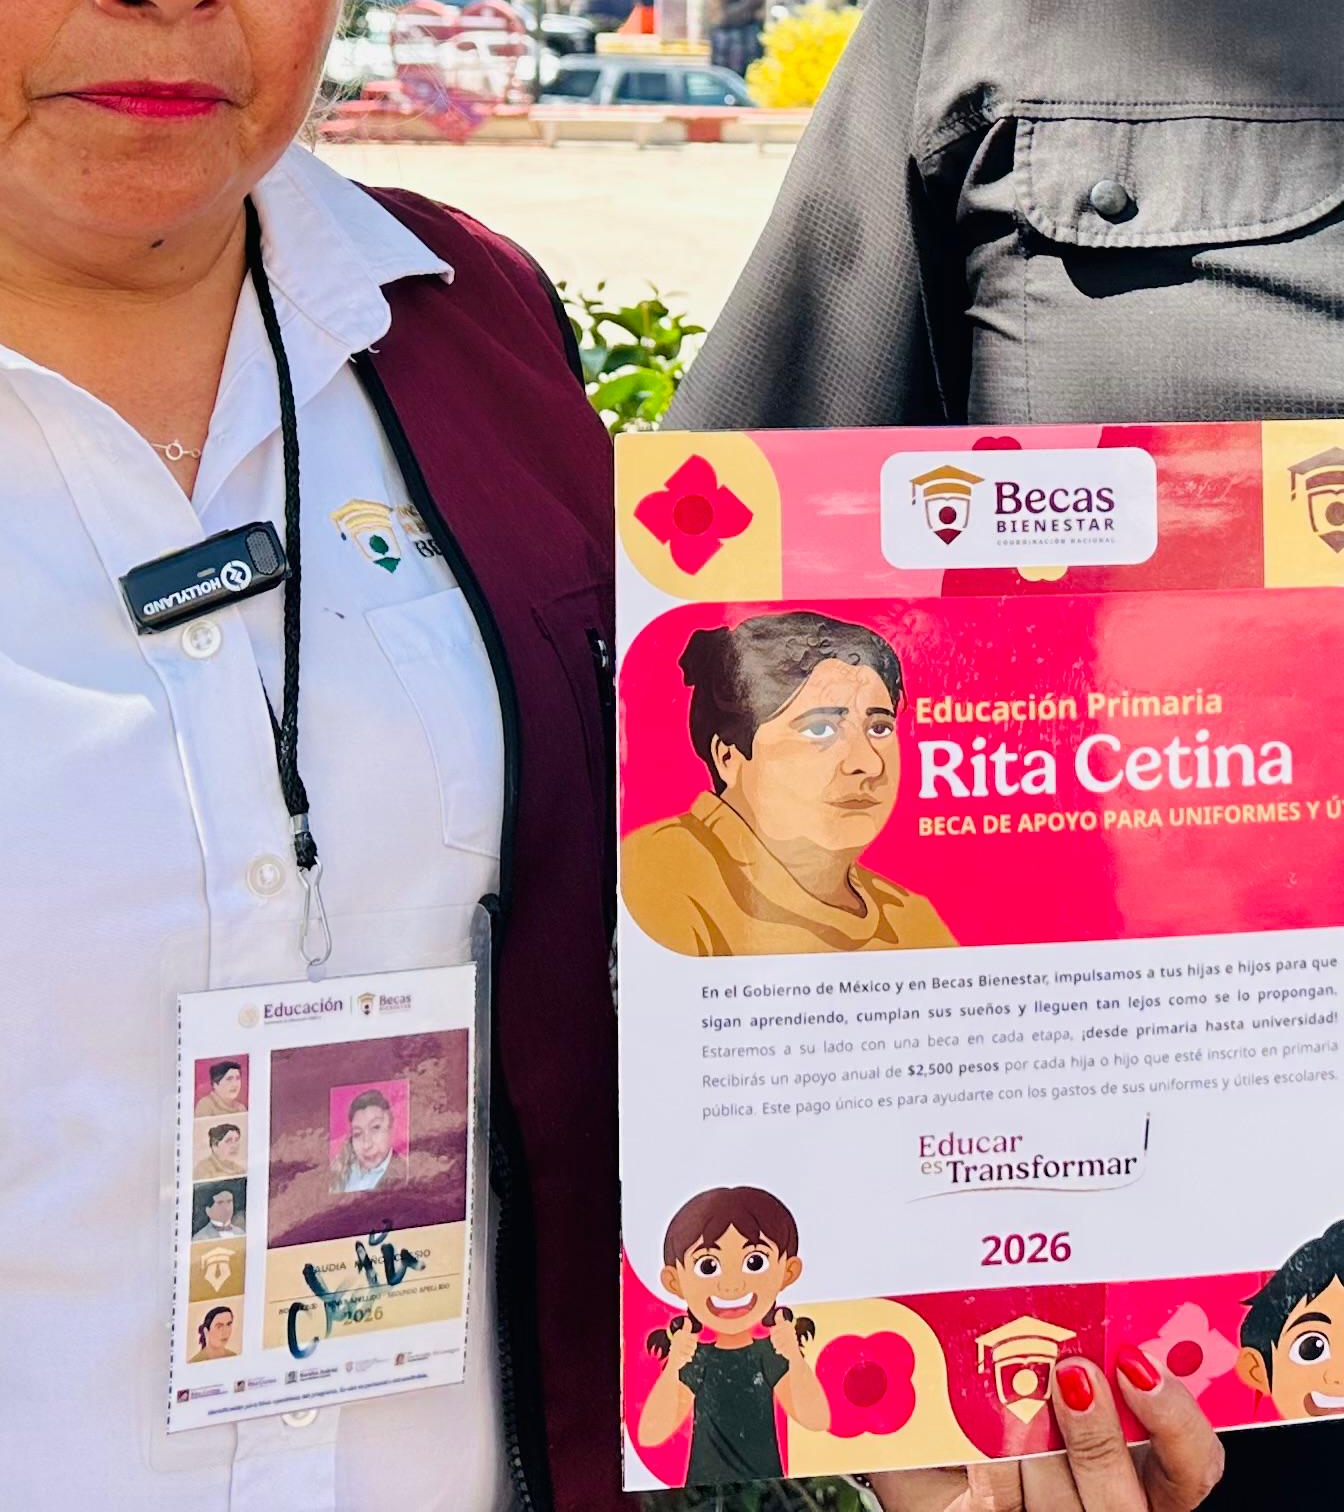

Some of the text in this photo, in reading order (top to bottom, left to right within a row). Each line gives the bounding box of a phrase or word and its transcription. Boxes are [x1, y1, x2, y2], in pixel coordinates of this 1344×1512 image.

[995, 481, 1115, 515] Becas
[997, 518, 1115, 533] BIENESTAR
[143, 576, 221, 615] HOLLYLAND
[916, 689, 1223, 724] Educación Primaria
[918, 728, 1293, 799] Rita Cetina
[918, 815, 976, 836] BECA
[983, 814, 1012, 834] DE
[1017, 811, 1097, 833] APOYO
[1104, 807, 1162, 829] PARA
[1169, 801, 1301, 826] UNIFORMES
[1306, 800, 1320, 820] Y
[702, 957, 1338, 999] En el Gobierno de México y en Becas Bienestar, impulsamos a tus hijas e hijos para que
[264, 997, 343, 1019] Educación
[701, 1014, 741, 1031] sigan
[749, 1011, 848, 1030] aprendiendo,
[856, 1008, 920, 1024] cumplan
[927, 1005, 952, 1018] sus
[960, 1002, 1011, 1017] sueños
[1018, 1003, 1027, 1016] y
[1034, 999, 1088, 1015] lleguen
[1096, 997, 1120, 1010] tan
[1128, 994, 1160, 1012] lejos
[1168, 993, 1207, 1006] como
[1215, 992, 1230, 1003] se
[1238, 988, 1250, 1003] lo
[702, 1043, 775, 1058] Estaremos
[783, 1043, 791, 1055] a
[799, 1043, 815, 1055] su
[823, 1039, 853, 1054] lado
[861, 1040, 886, 1051] con
[894, 1038, 919, 1049] una
[927, 1034, 959, 1047] beca
[967, 1034, 984, 1045] en
[991, 1029, 1024, 1044] cada
[1082, 1024, 1128, 1040] ¡desde
[1136, 1022, 1197, 1039] primaria
[1206, 1018, 1244, 1032] hasta
[1252, 1012, 1338, 1030] universidad!
[702, 1040, 1338, 1088] Recibirás un apoyo anual de $2,500 pesos por cada hija o hijo que esté inscrito en primaria
[762, 1100, 791, 1115] Este
[795, 1100, 831, 1116] pago
[836, 1095, 873, 1111] único
[878, 1096, 892, 1107] es
[897, 1094, 928, 1109] para
[932, 1088, 994, 1104] ayudarte
[998, 1088, 1023, 1100] con
[1028, 1083, 1047, 1098] los
[1051, 1082, 1096, 1100] gastos
[1101, 1080, 1118, 1094] de
[1122, 1081, 1145, 1093] sus
[1150, 1074, 1218, 1092] uniformes
[1222, 1076, 1229, 1091] y
[1234, 1071, 1270, 1087] útiles
[919, 1131, 1023, 1158] Educar
[921, 1154, 1137, 1183] es Transformar
[980, 1231, 1072, 1266] 2026
